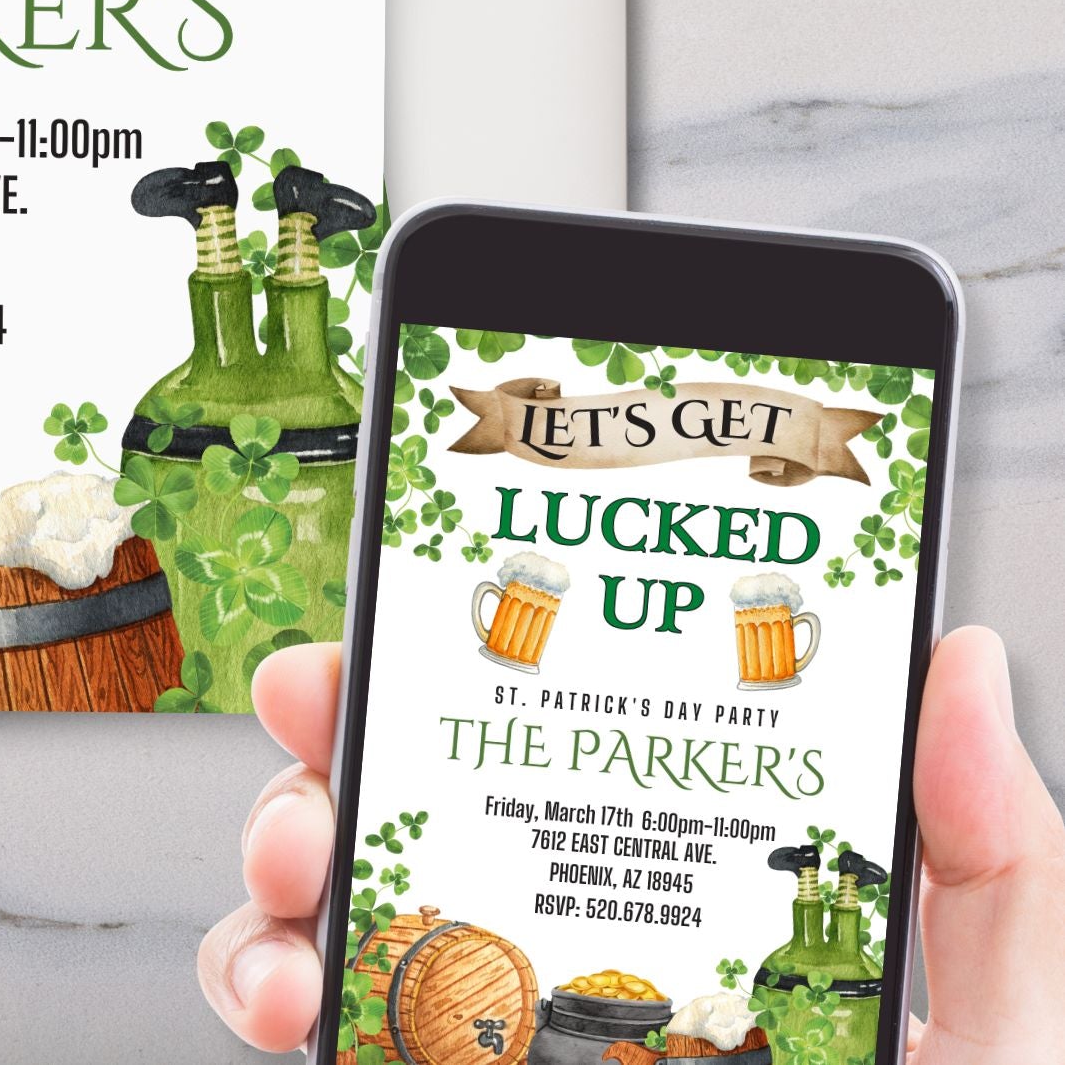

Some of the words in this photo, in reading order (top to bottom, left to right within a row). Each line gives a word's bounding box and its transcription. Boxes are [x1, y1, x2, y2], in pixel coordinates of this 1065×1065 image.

[519, 402, 656, 461] LET'S
[671, 399, 793, 447] GET
[490, 486, 821, 565] LUCKED
[598, 573, 705, 635] UP
[494, 685, 527, 707] ST.
[540, 689, 651, 718] PATRICK'S
[663, 700, 703, 722] DAY
[714, 704, 780, 729] PARTY
[439, 716, 552, 770] THE
[567, 729, 825, 800] PARKER'S
[484, 795, 539, 824] Friday,
[544, 800, 596, 825] March
[600, 805, 634, 829] 17th
[531, 828, 567, 852] 7612
[571, 832, 610, 855] EAST
[613, 835, 679, 862] CENTRAL
[683, 842, 717, 865] AVE.
[549, 861, 618, 891] PHOENIX,
[622, 868, 643, 890] AZ
[646, 870, 694, 894] 18945
[534, 892, 581, 918] RSVP:
[585, 897, 703, 928] 520.678.9924
